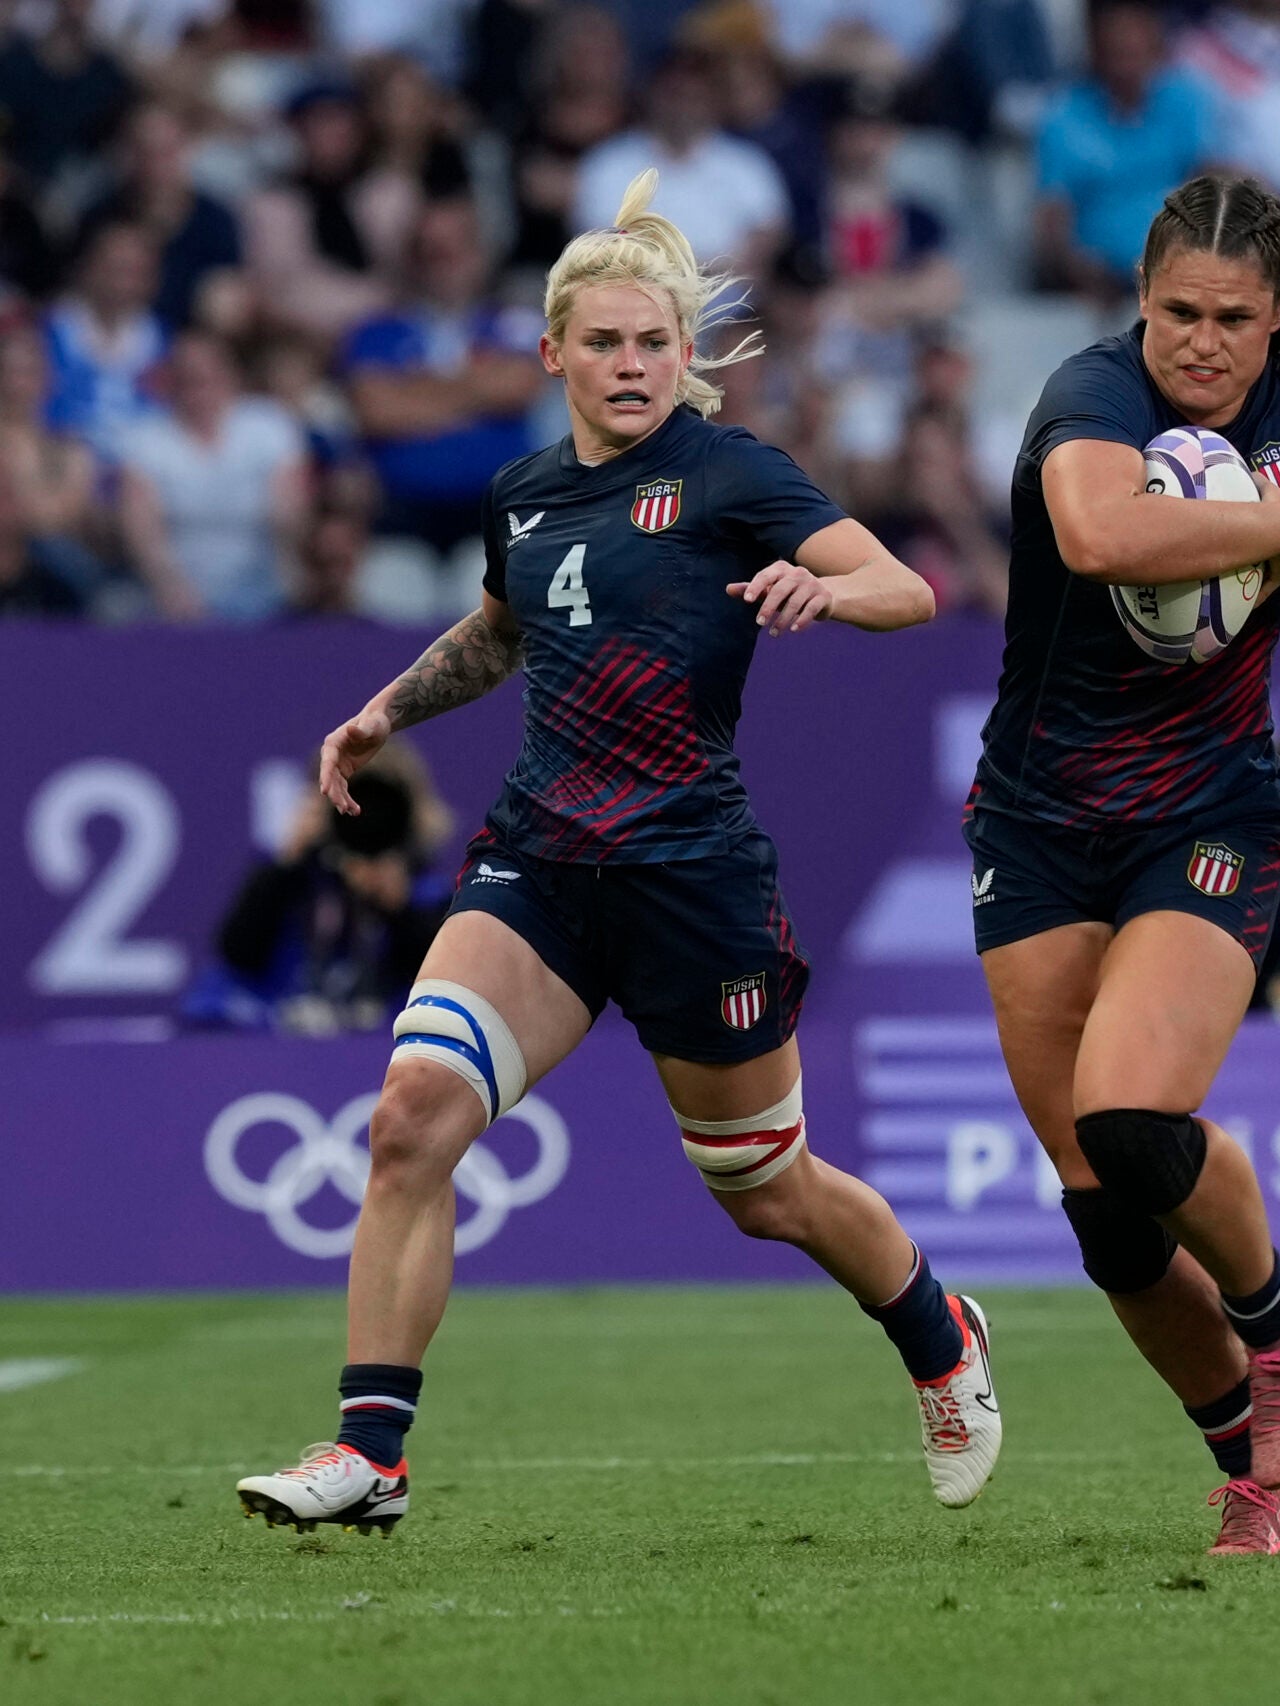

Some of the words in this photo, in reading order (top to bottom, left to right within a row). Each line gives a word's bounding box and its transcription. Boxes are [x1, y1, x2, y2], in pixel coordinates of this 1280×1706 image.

[647, 484, 670, 497] USA
[547, 543, 592, 627] 4
[1206, 846, 1233, 865] USA
[733, 978, 755, 993] USA
